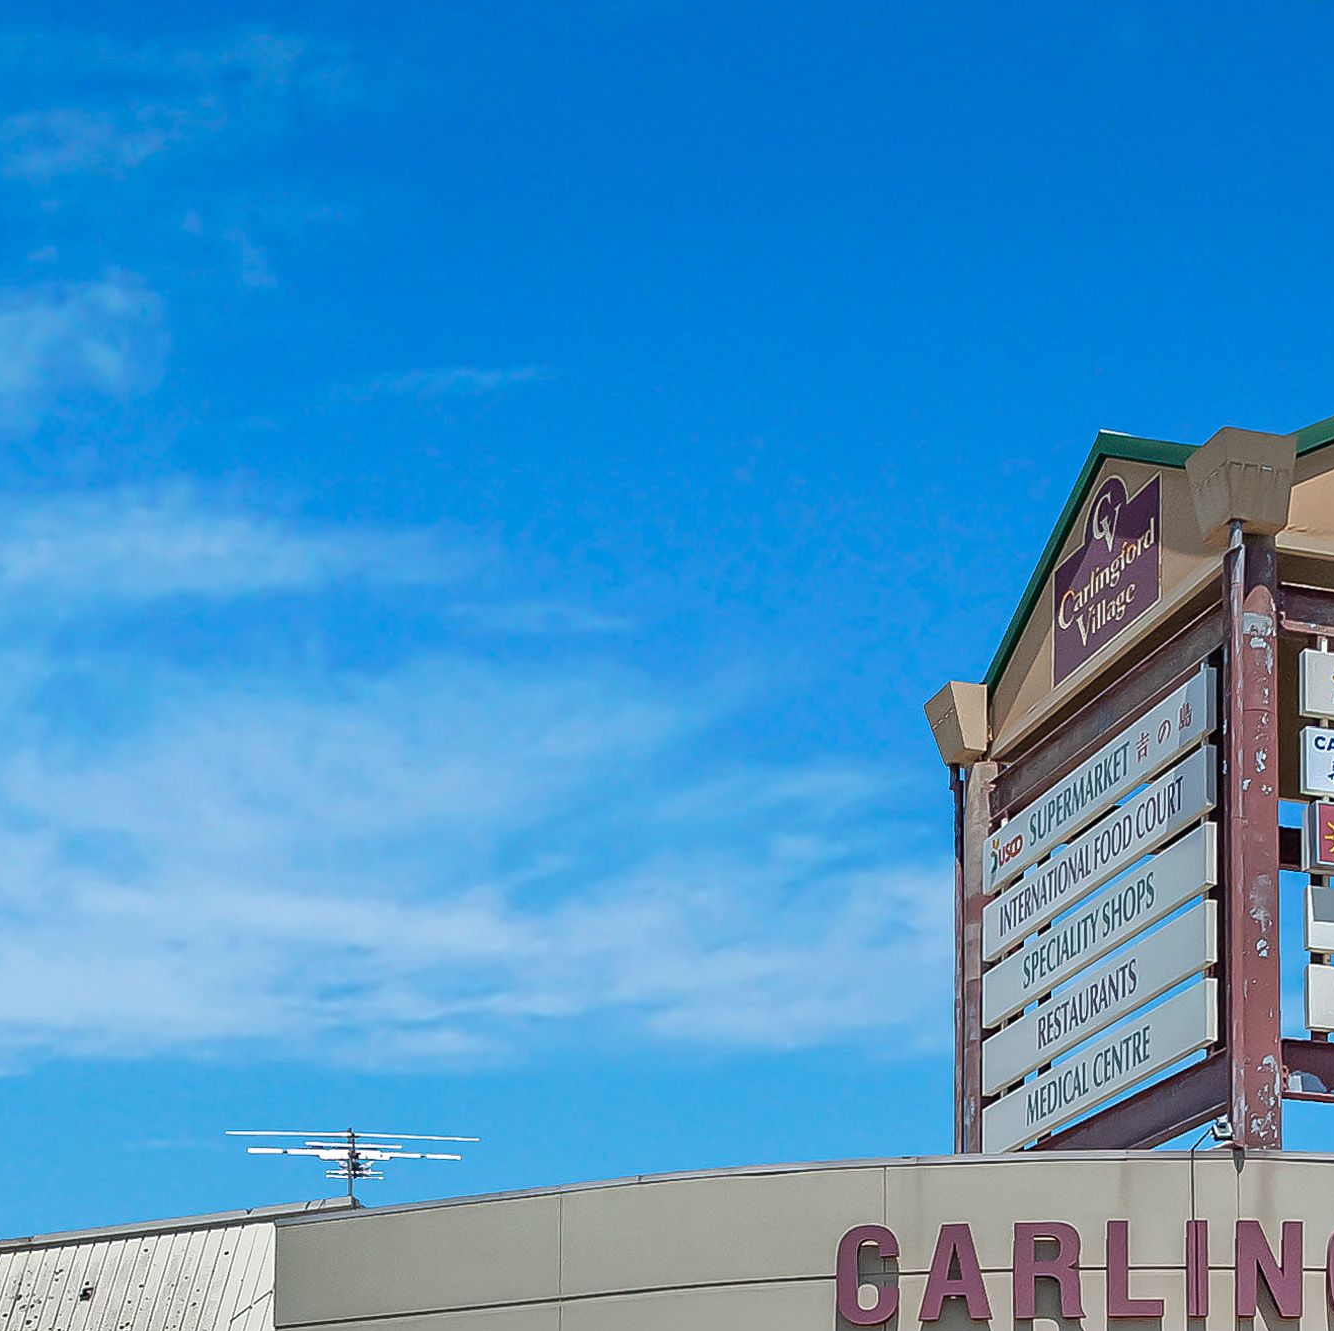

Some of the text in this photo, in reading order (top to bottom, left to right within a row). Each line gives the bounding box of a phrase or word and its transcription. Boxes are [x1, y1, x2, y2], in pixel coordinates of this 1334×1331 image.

[1058, 517, 1156, 631] Carlingford
[1076, 583, 1137, 647] Village
[1029, 741, 1130, 847] SUPERMARKET
[999, 776, 1184, 937] INTERNATIONAL FOOD COURT
[1023, 871, 1154, 989] SPECIALITY SHOPS
[1037, 958, 1137, 1050] RESTAURANTS
[1026, 1025, 1151, 1127] MEDICAL CENTRE
